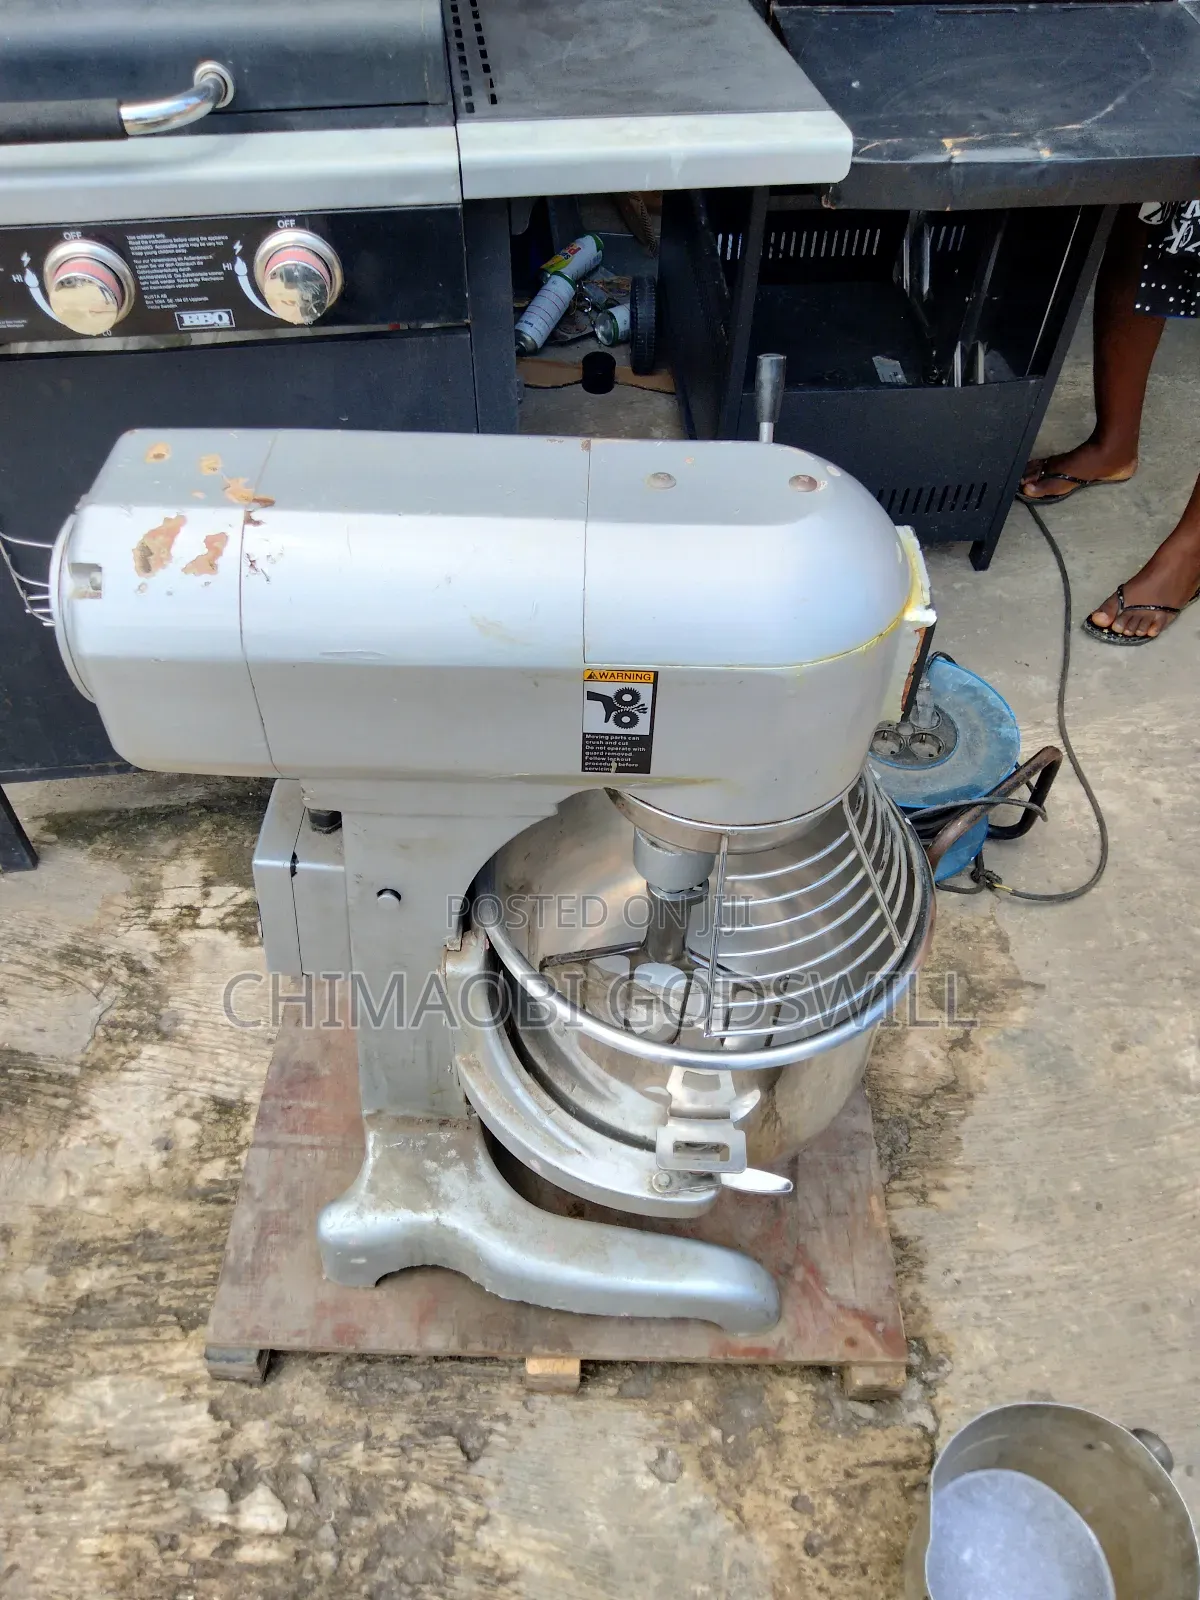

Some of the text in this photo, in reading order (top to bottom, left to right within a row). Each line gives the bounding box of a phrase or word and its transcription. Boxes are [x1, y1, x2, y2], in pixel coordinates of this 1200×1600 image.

[277, 219, 296, 229] OFF
[63, 231, 82, 240] OFF
[222, 262, 233, 271] HI
[11, 274, 24, 283] HI
[599, 671, 651, 681] WARNING
